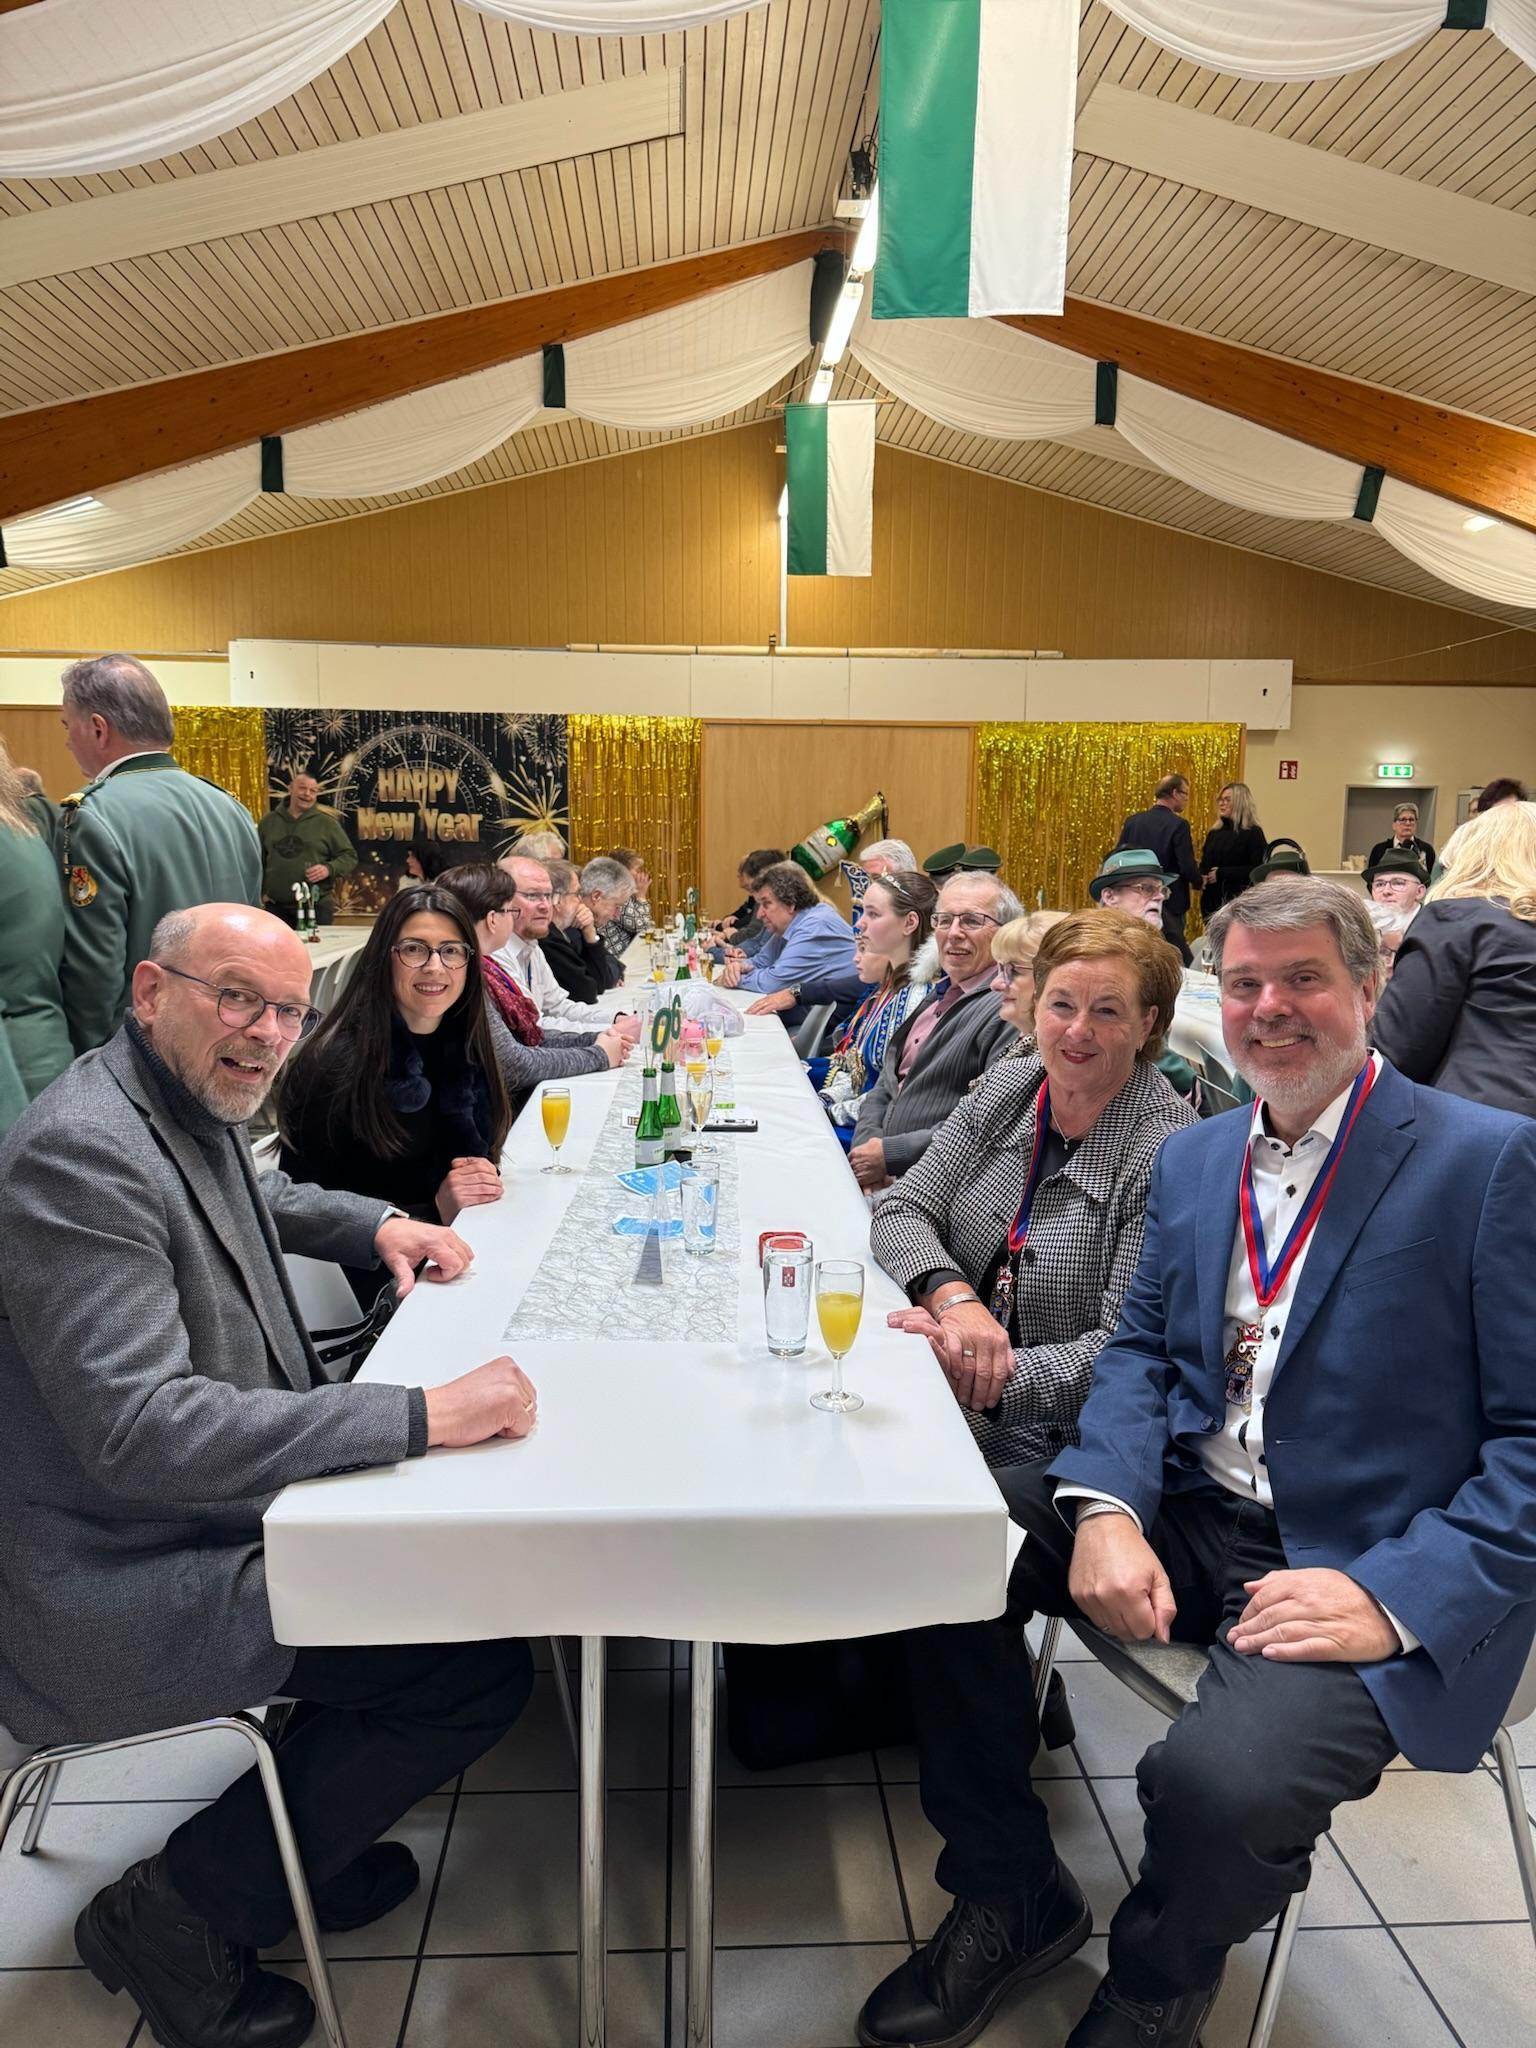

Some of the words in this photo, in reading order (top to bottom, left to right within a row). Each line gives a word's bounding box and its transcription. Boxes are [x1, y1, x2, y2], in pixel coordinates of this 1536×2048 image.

[378, 769, 460, 802] HAPPY
[357, 807, 416, 841] New
[422, 808, 483, 842] Year
